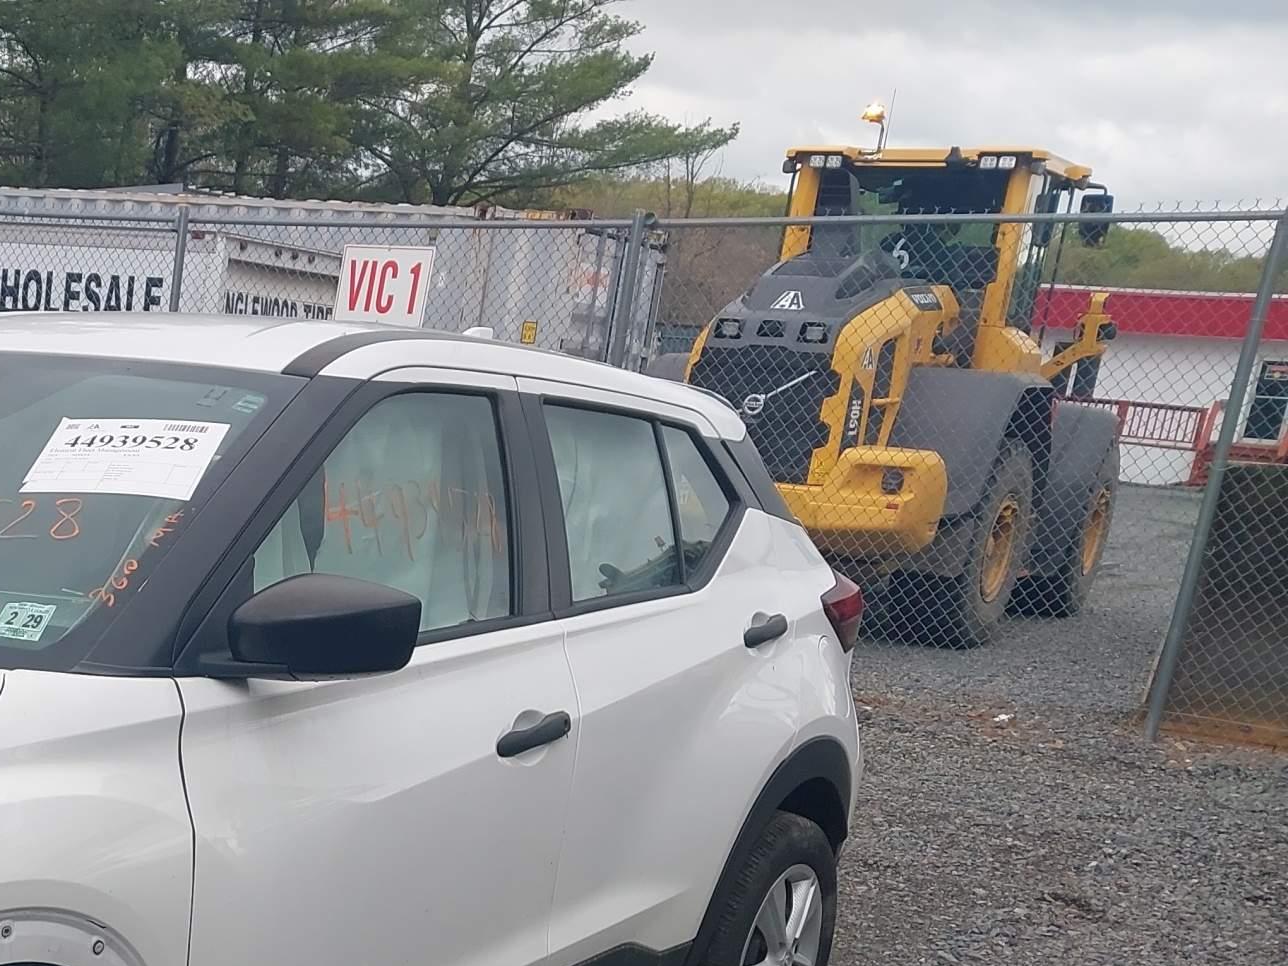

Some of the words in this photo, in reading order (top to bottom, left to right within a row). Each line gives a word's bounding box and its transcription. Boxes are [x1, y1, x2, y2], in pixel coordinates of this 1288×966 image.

[348, 258, 399, 315] VIC
[407, 261, 423, 315] 1
[64, 434, 199, 451] 44939528
[5, 611, 19, 626] 2
[21, 614, 44, 629] 29
